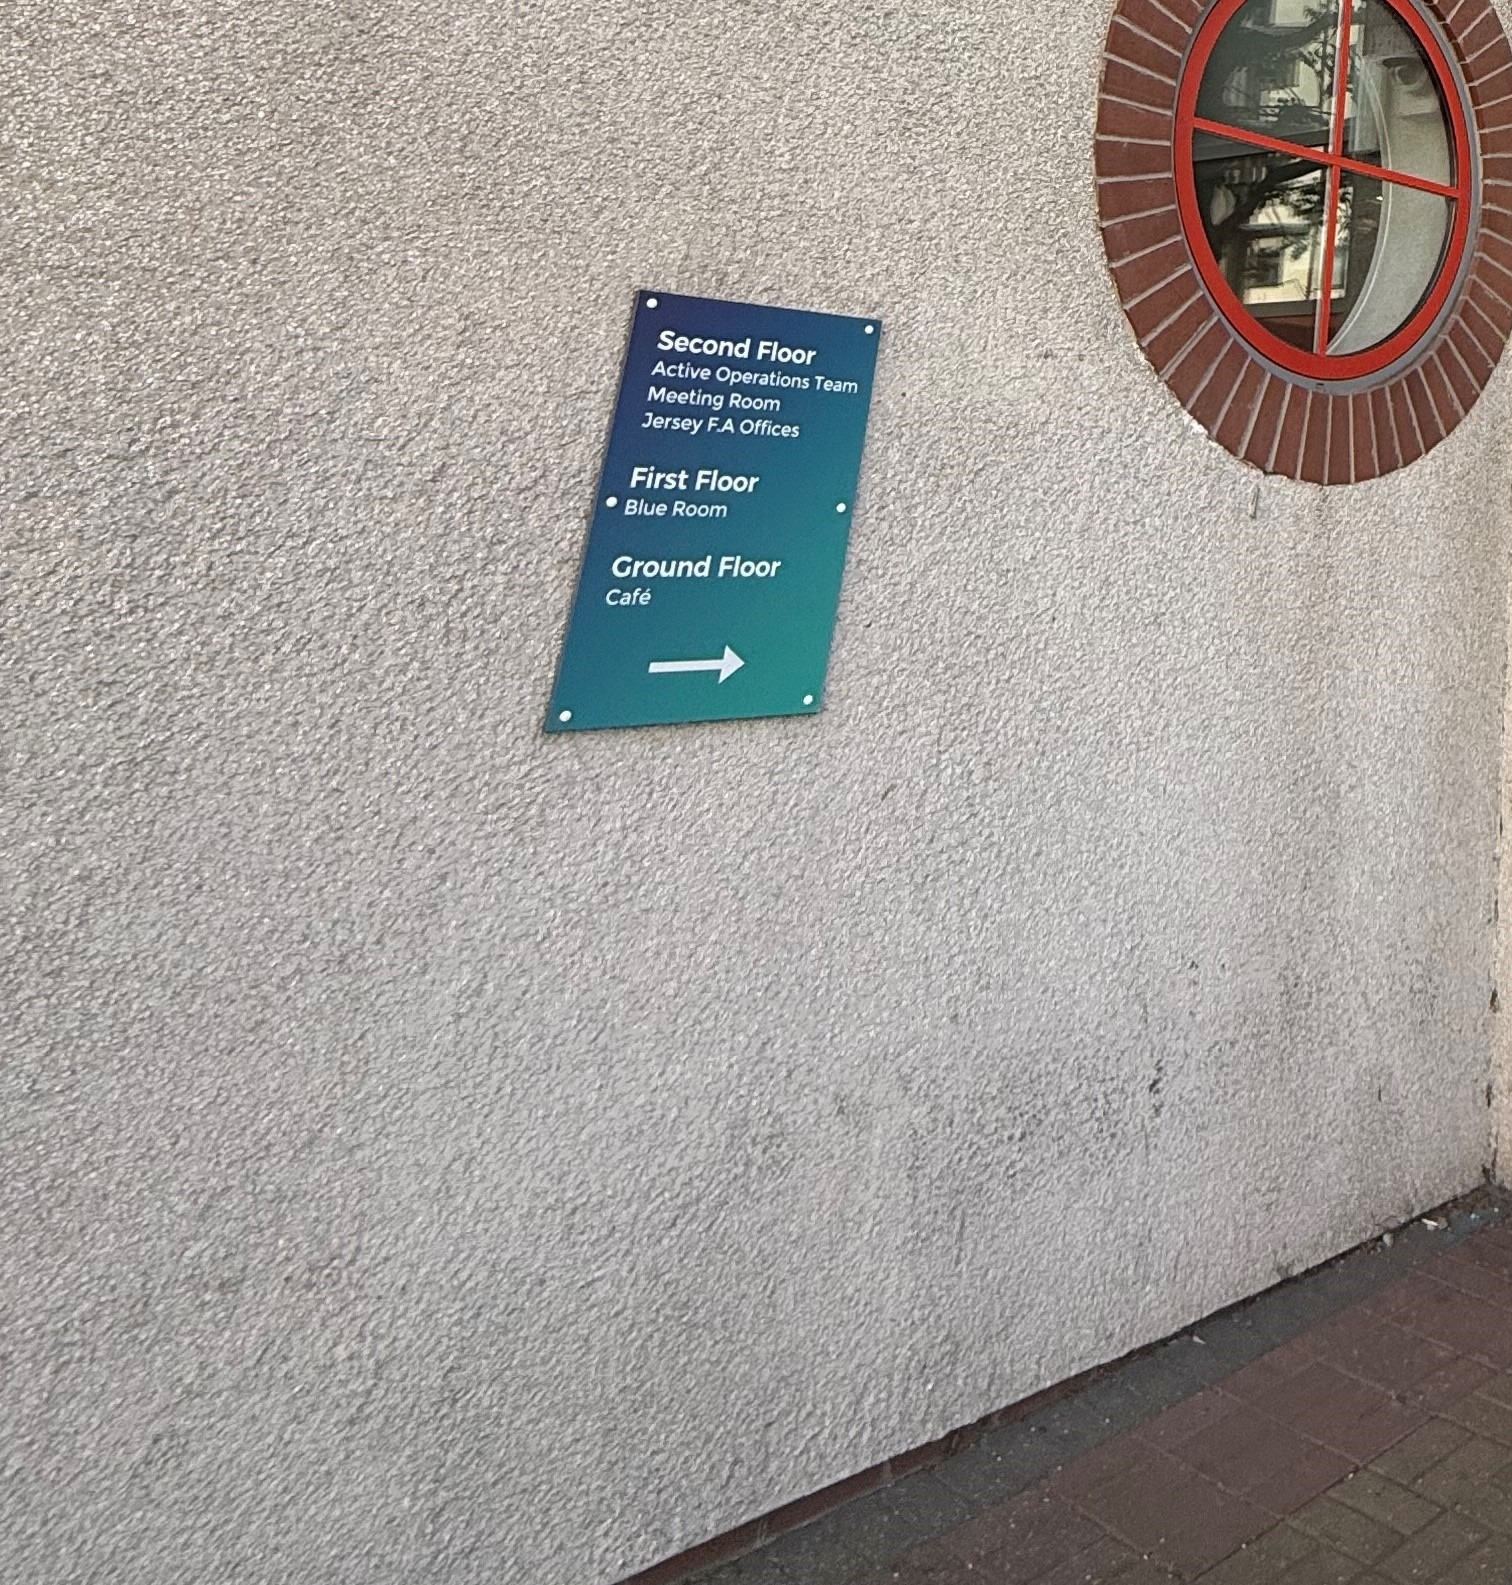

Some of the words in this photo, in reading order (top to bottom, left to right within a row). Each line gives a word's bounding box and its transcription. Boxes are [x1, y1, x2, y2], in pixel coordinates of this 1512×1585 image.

[657, 331, 751, 358] Second
[757, 341, 816, 365] Floor
[651, 361, 711, 380] Active
[716, 367, 809, 389] Operations
[815, 376, 857, 393] Team
[648, 386, 724, 410] Meeting
[729, 393, 780, 411] Room
[642, 413, 703, 435] Jersey
[707, 417, 734, 433] F.A
[740, 419, 799, 437] Offices
[630, 466, 689, 490] First
[695, 470, 759, 492] Floor
[625, 499, 667, 516] Blue
[672, 501, 727, 517] Room
[612, 556, 712, 577] Ground
[718, 556, 781, 577] Floor
[606, 588, 651, 605] Café
